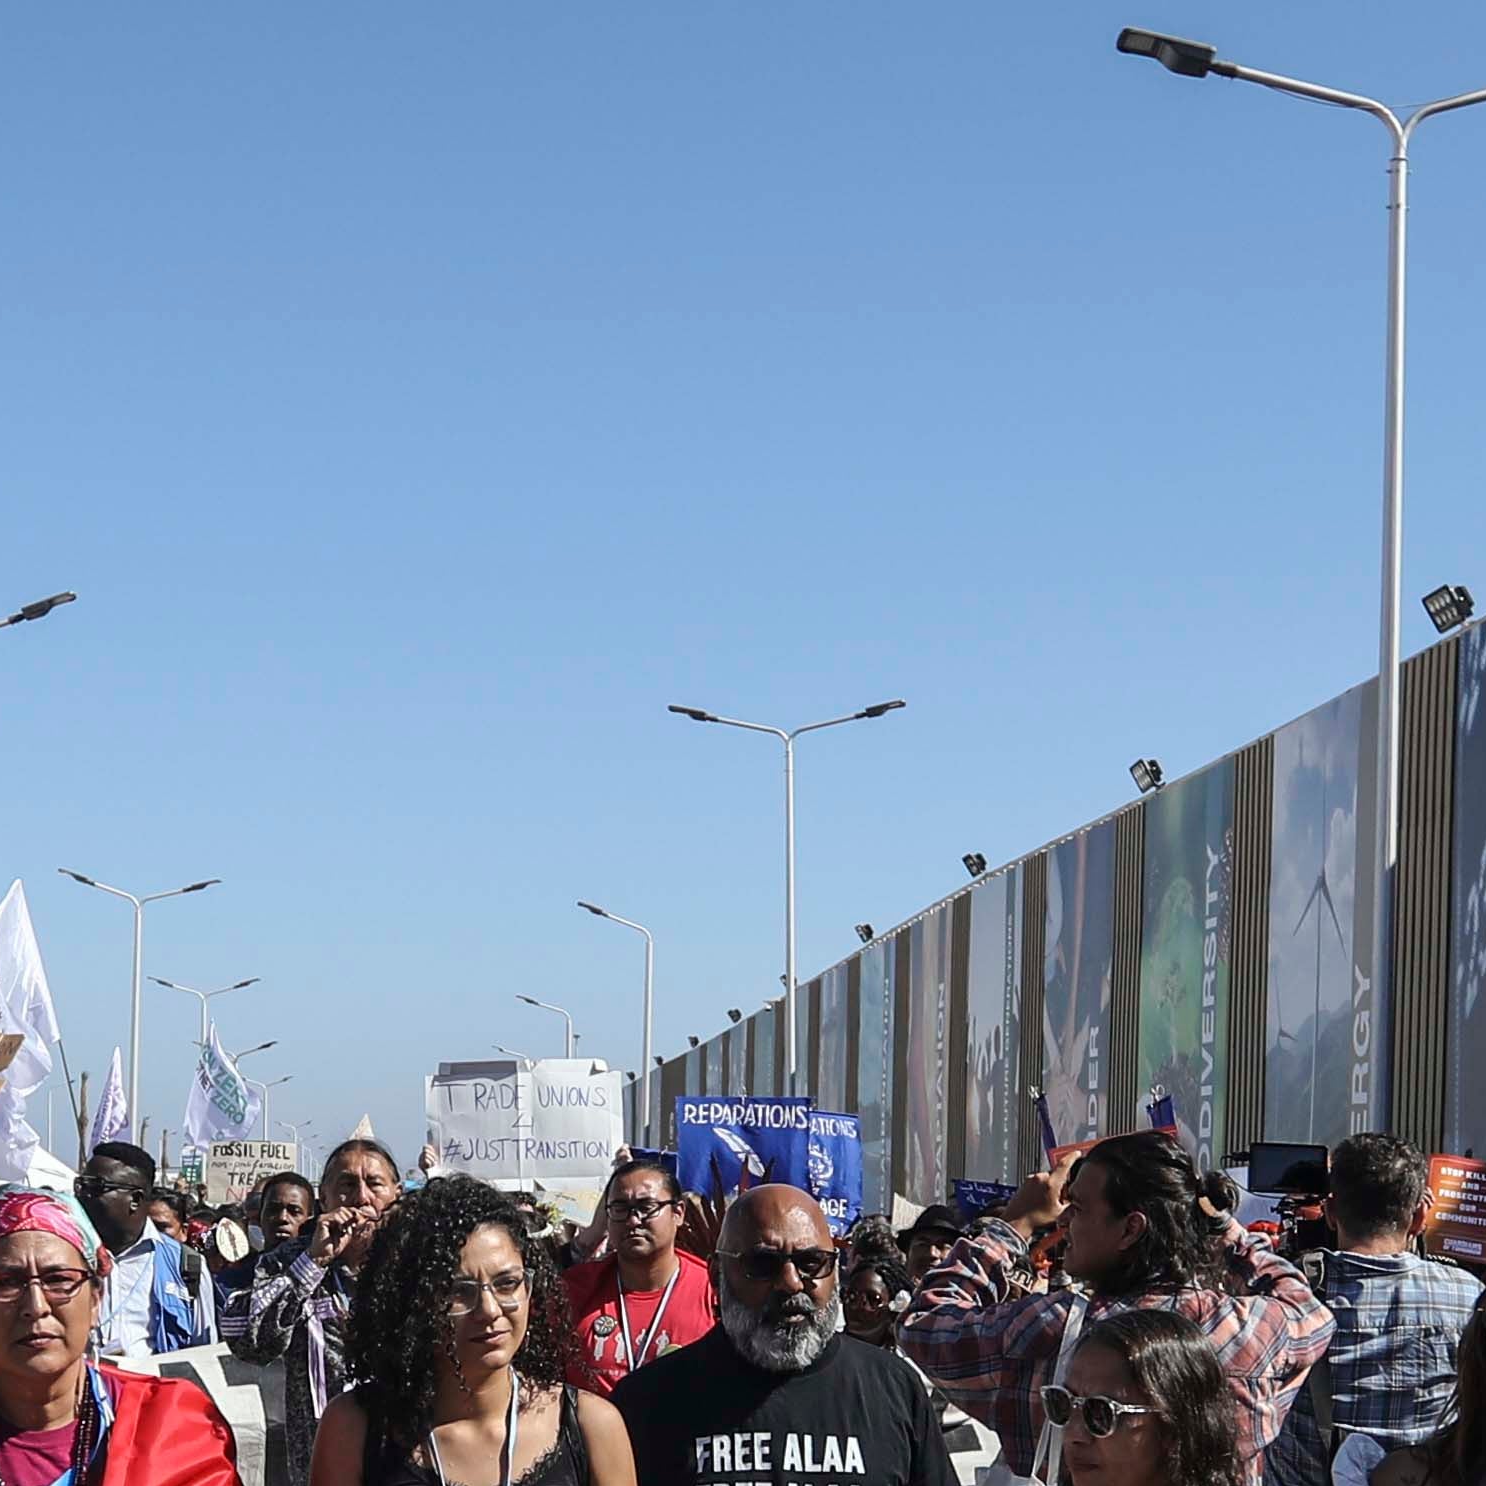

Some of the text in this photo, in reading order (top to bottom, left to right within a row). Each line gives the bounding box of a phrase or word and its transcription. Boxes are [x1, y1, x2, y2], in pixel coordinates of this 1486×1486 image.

[209, 1090, 245, 1125] ZERO
[538, 1086, 607, 1108] UNIONS
[682, 1103, 809, 1129] REPARATIONS
[212, 1141, 291, 1160] FOSSIL FUEL
[1440, 1166, 1465, 1178] STOP
[695, 1432, 866, 1475] FREE ALAA
